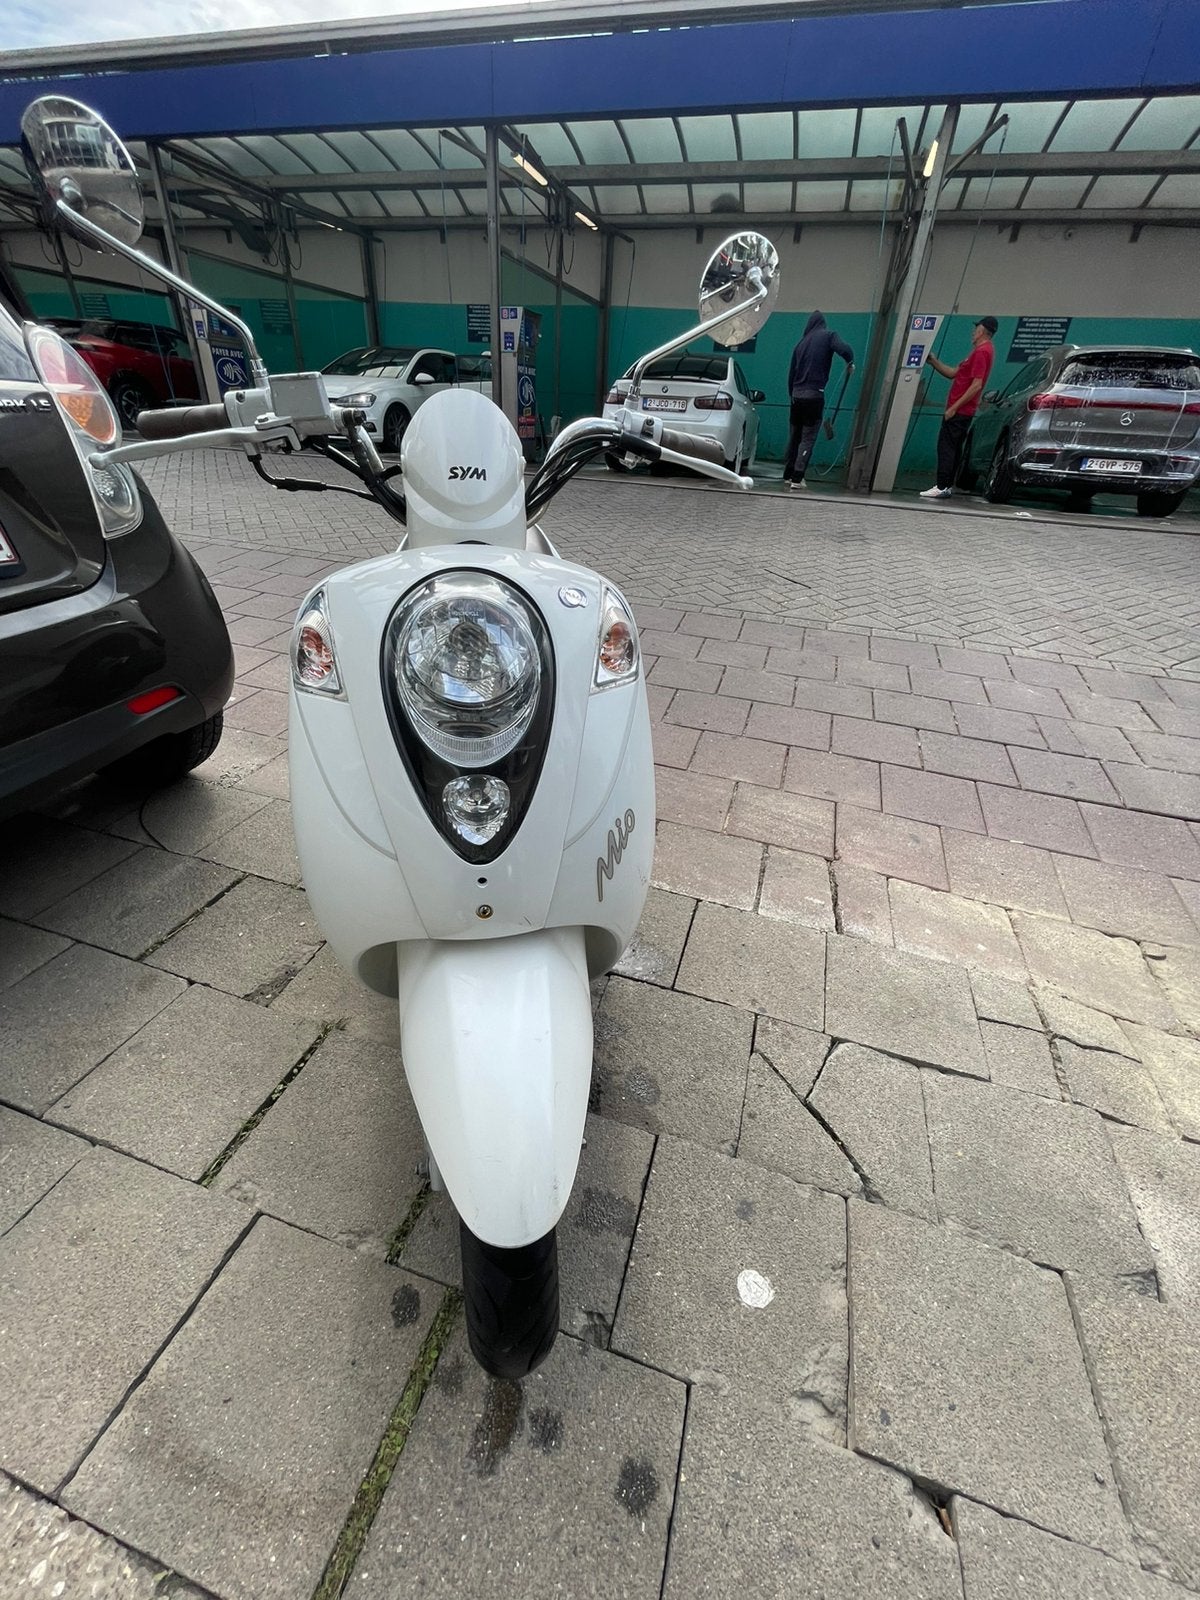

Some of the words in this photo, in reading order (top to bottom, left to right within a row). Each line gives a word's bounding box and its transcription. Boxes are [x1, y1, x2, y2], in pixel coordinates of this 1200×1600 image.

[230, 350, 244, 359] AVEC
[1087, 459, 1141, 471] 2-GVP-575
[448, 466, 487, 481] SYM
[597, 808, 636, 903] Mio
